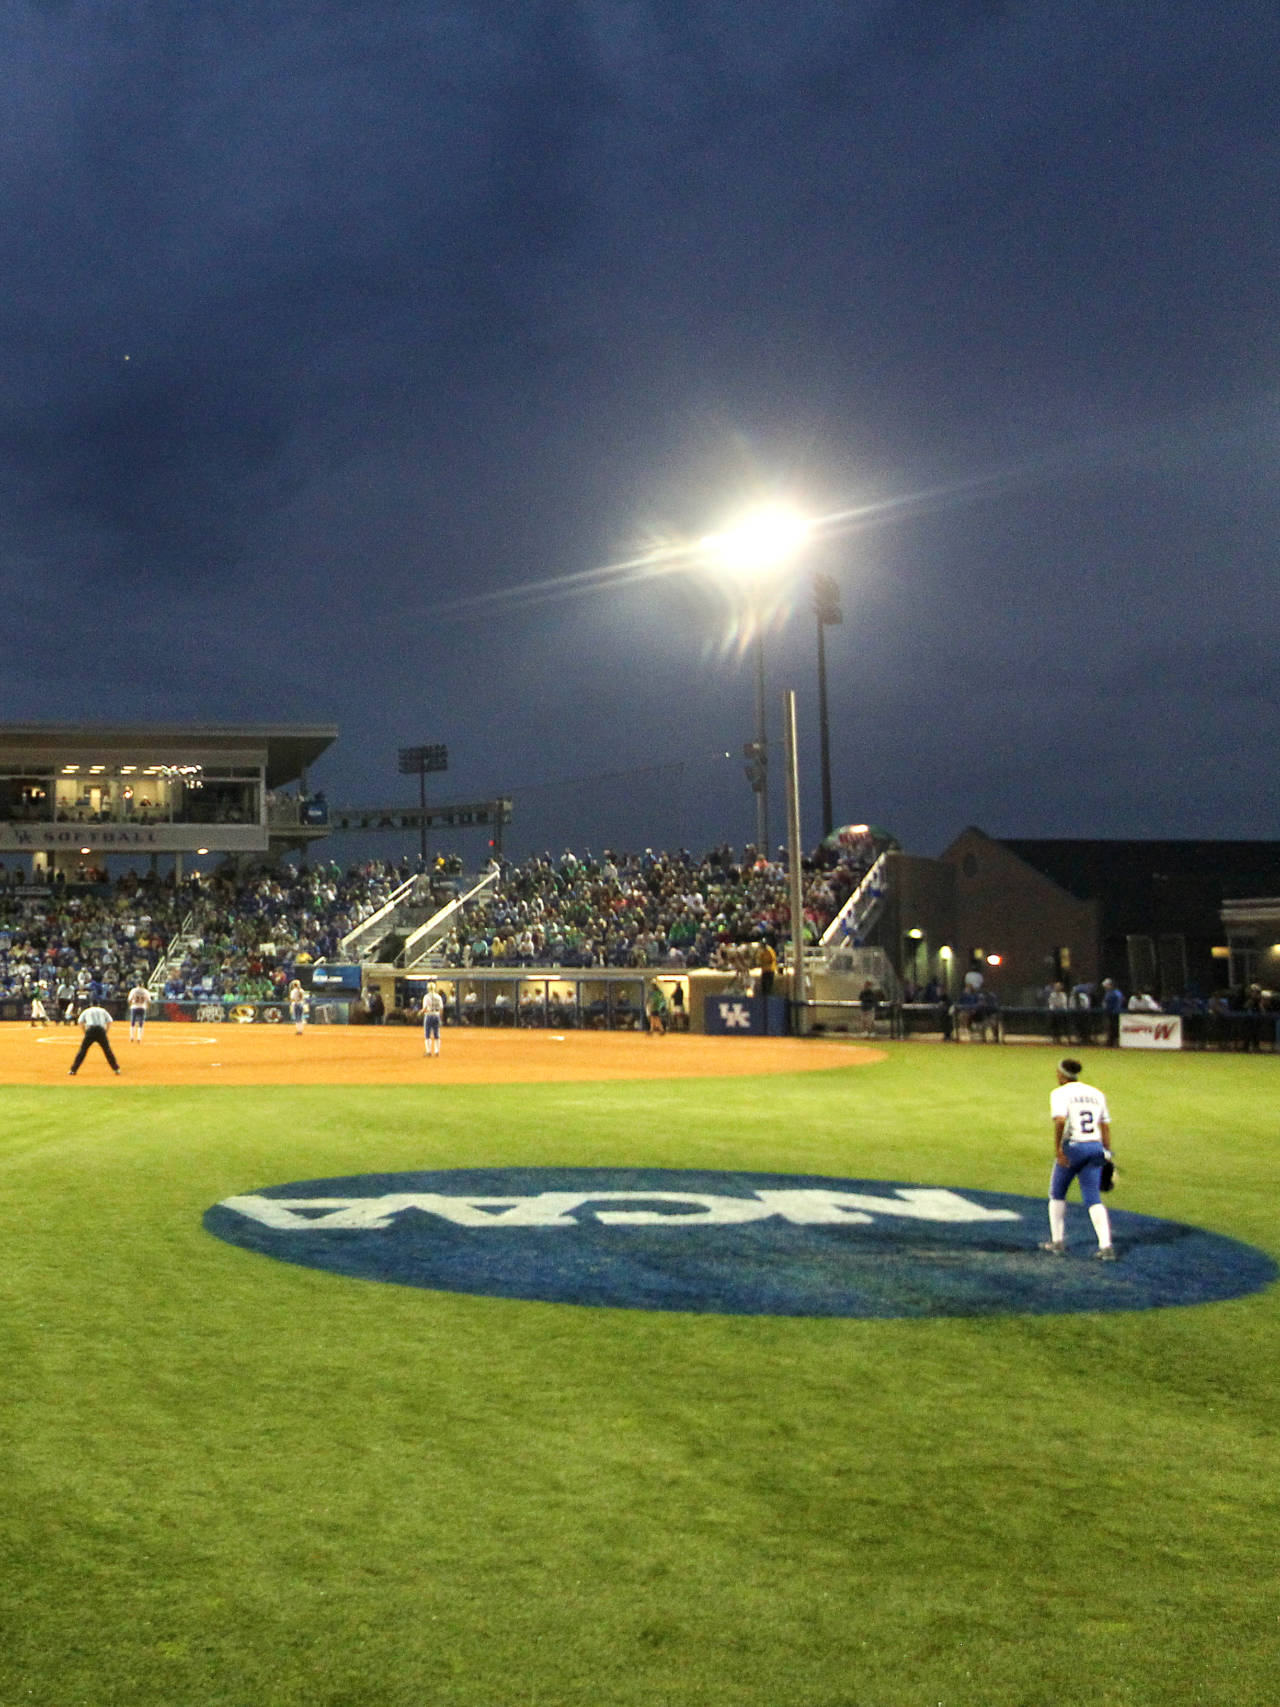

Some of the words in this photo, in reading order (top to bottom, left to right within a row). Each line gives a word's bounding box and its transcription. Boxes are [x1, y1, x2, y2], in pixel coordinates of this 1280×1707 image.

[44, 831, 156, 843] SOFTBALL
[719, 1002, 751, 1029] UK
[1079, 1110, 1094, 1134] 2
[220, 1189, 1023, 1229] NCAA
